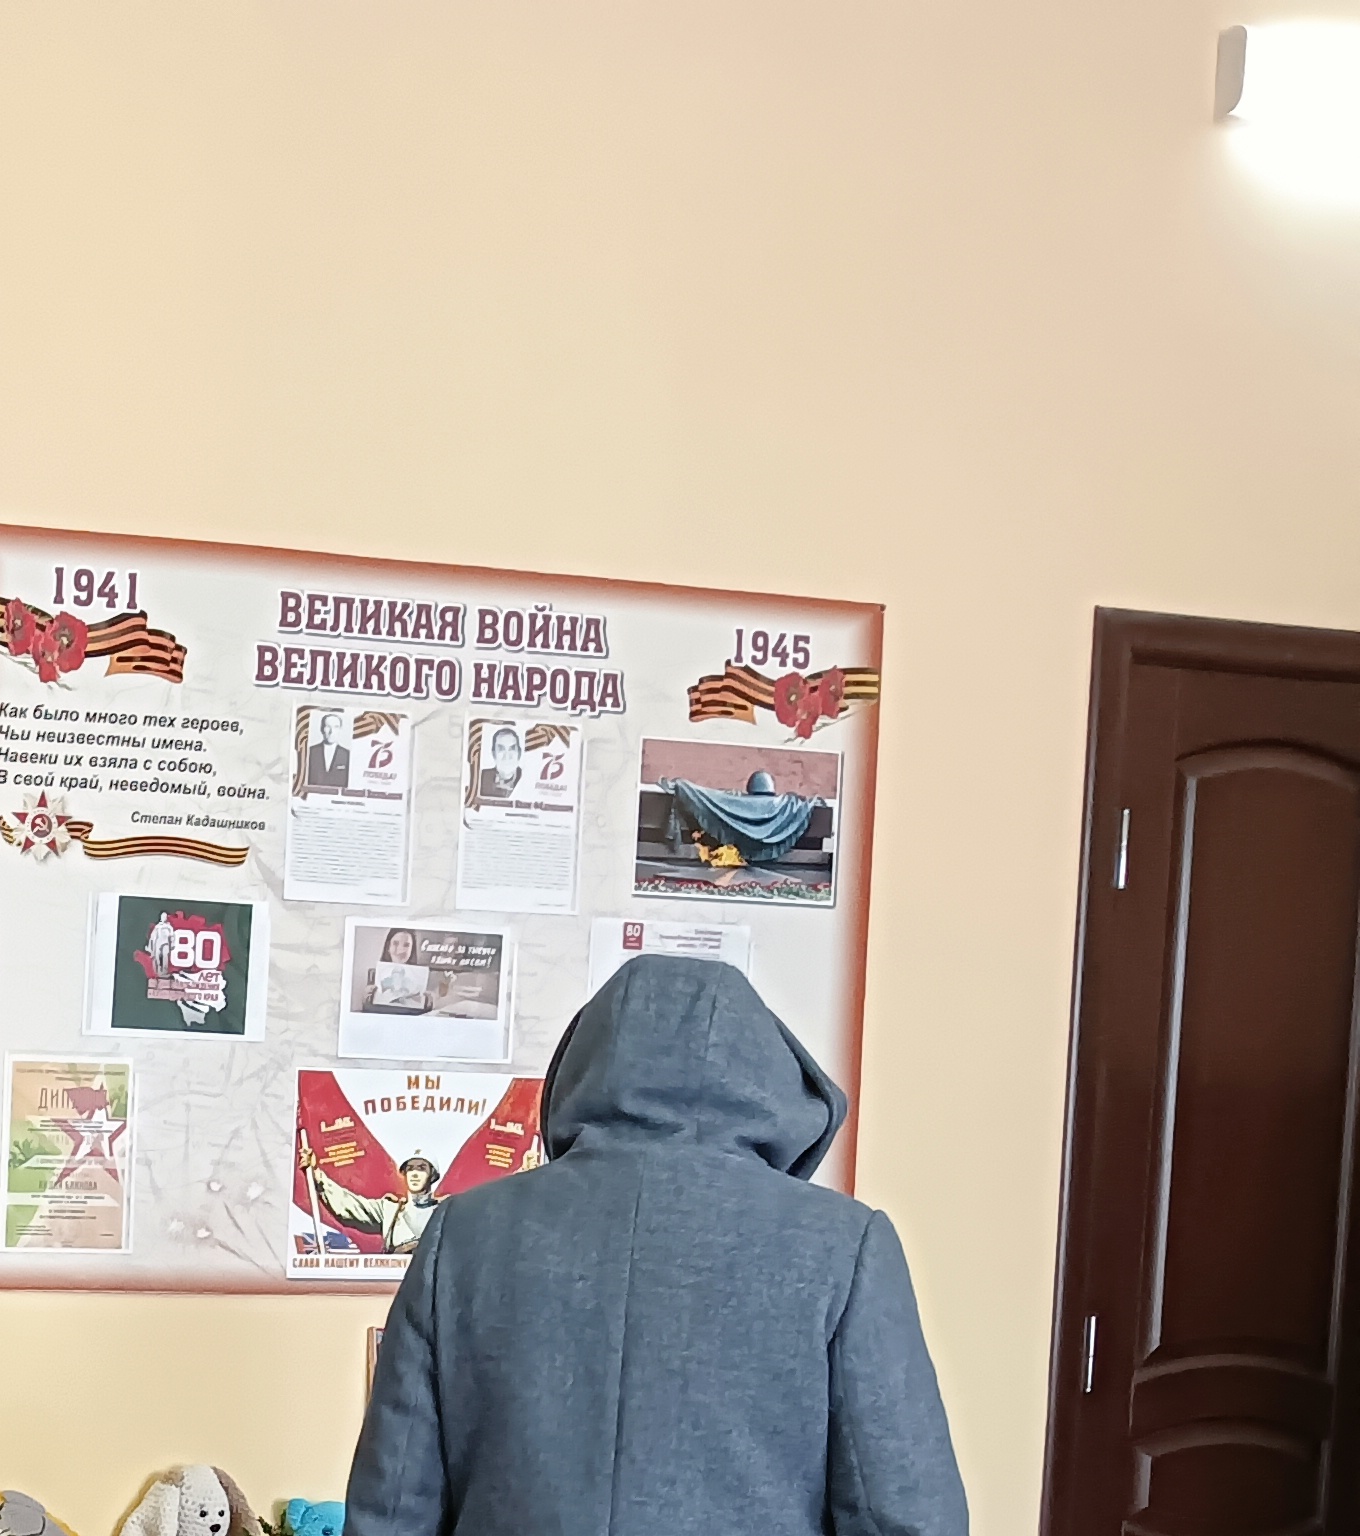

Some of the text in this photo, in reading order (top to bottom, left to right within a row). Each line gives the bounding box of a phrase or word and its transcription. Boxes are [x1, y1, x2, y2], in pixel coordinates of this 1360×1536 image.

[53, 567, 138, 610] 1941
[278, 591, 605, 653] ВЕЛИКАЯ ВОЙНА
[734, 629, 810, 669] 1945
[255, 644, 623, 712] ВЕЛИКОГО НАРОДА
[32, 704, 80, 722] было
[84, 713, 138, 726] много
[142, 715, 176, 728] тех
[181, 718, 244, 735] героев,
[36, 731, 146, 749] неизвестны
[151, 739, 208, 752] имена.
[368, 740, 394, 768] 75
[63, 754, 83, 767] их
[89, 756, 138, 770] взяла
[143, 759, 153, 771] с
[157, 760, 218, 776] собою,
[540, 752, 565, 780] 75
[13, 771, 54, 787] свой
[59, 775, 103, 792] край,
[109, 780, 211, 799] неведомый,
[217, 785, 271, 800] война.
[130, 811, 266, 831] Степан Кадашников
[170, 929, 221, 969] 80
[407, 1075, 441, 1090] МЫ
[364, 1095, 487, 1116] ПОБЕДИЛИ!
[292, 1257, 320, 1268] СЛАВА
[324, 1257, 359, 1268] НАШЕМУ
